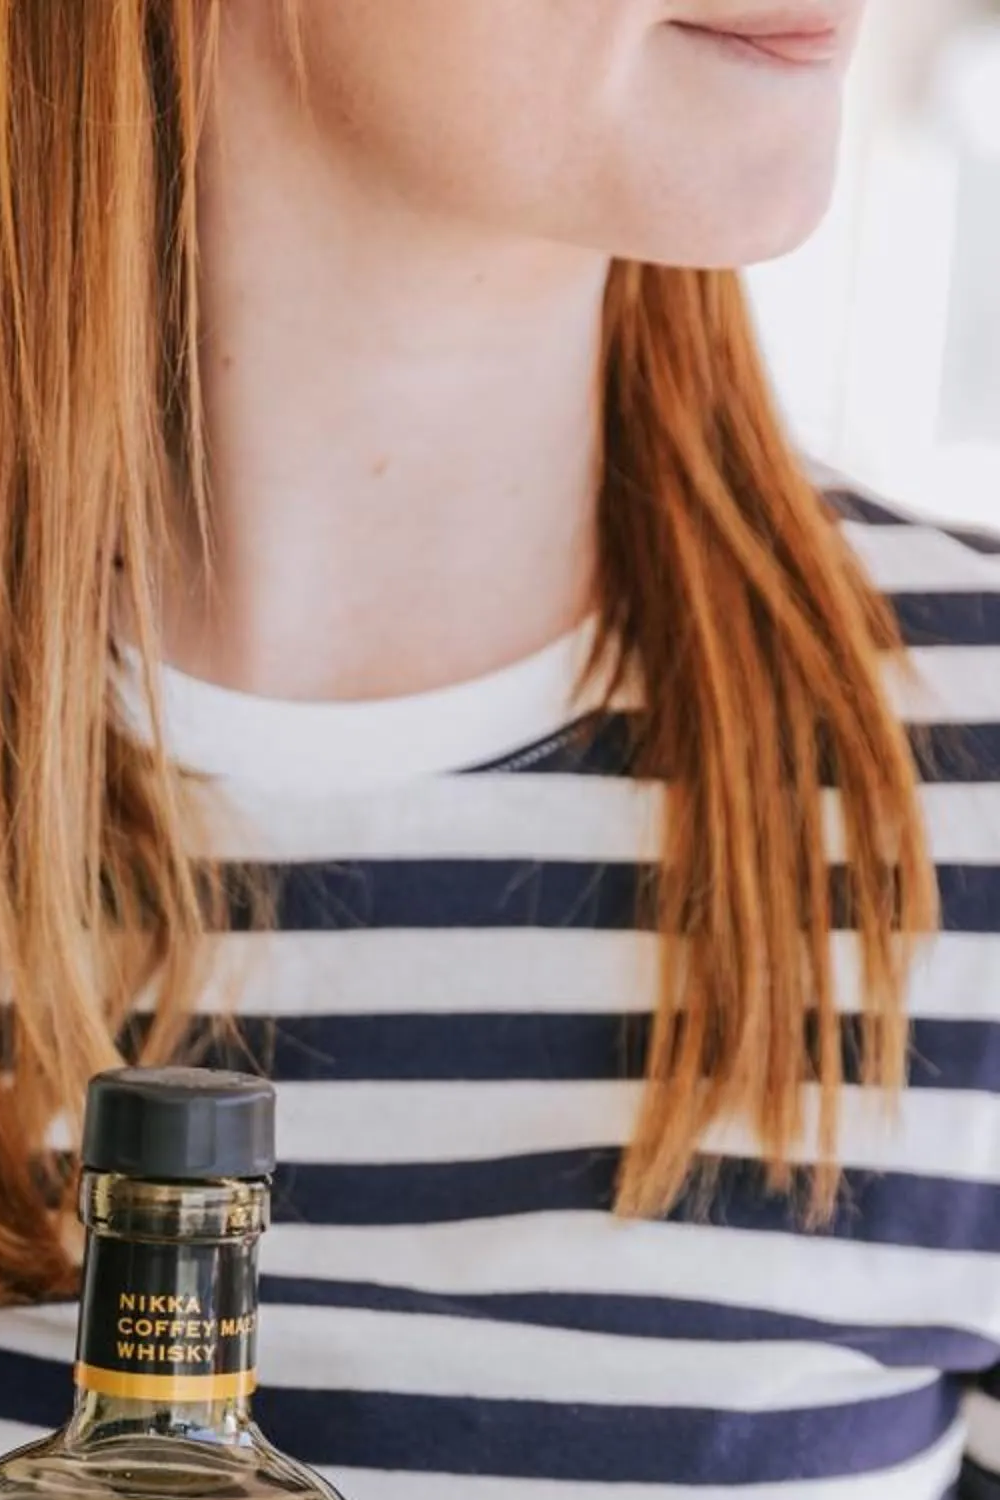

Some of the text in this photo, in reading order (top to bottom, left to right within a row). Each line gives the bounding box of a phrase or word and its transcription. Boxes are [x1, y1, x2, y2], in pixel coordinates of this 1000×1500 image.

[119, 1293, 201, 1313] NIKKA
[117, 1317, 216, 1338] COFFEY
[116, 1341, 217, 1362] WHISKY
